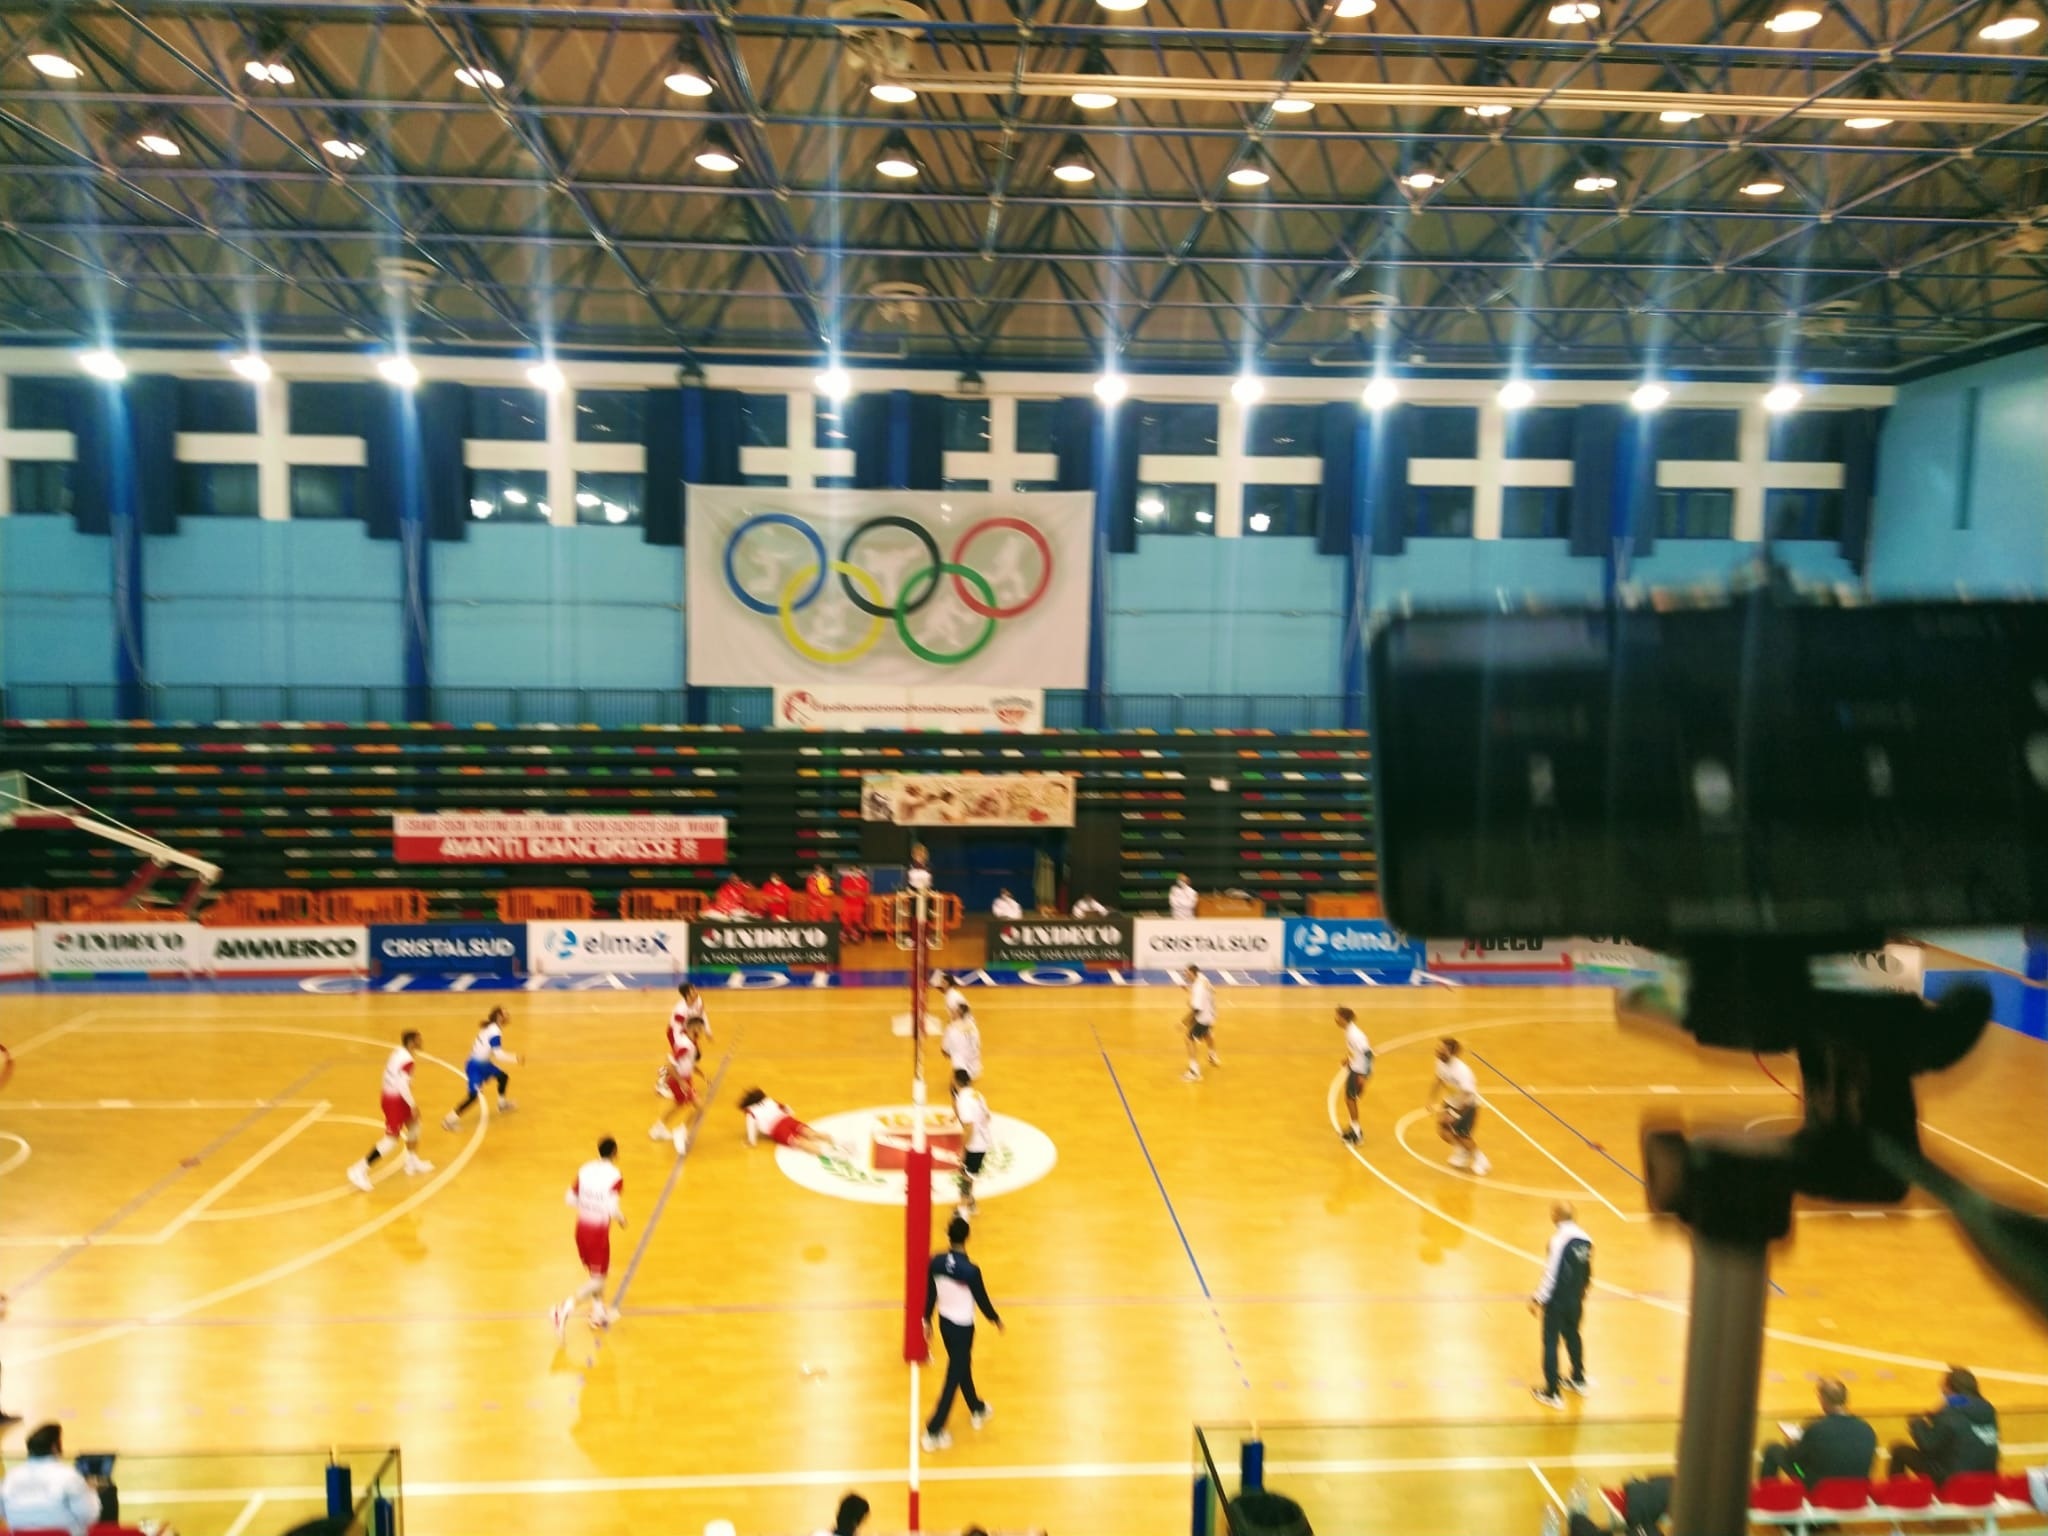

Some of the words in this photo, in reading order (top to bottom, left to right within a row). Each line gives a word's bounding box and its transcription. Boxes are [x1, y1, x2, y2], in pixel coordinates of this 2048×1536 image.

[722, 926, 828, 949] INDECO
[1021, 924, 1122, 945] INDECO
[1149, 934, 1269, 952] CRISTALSUD
[381, 937, 516, 958] CRISTALSUD
